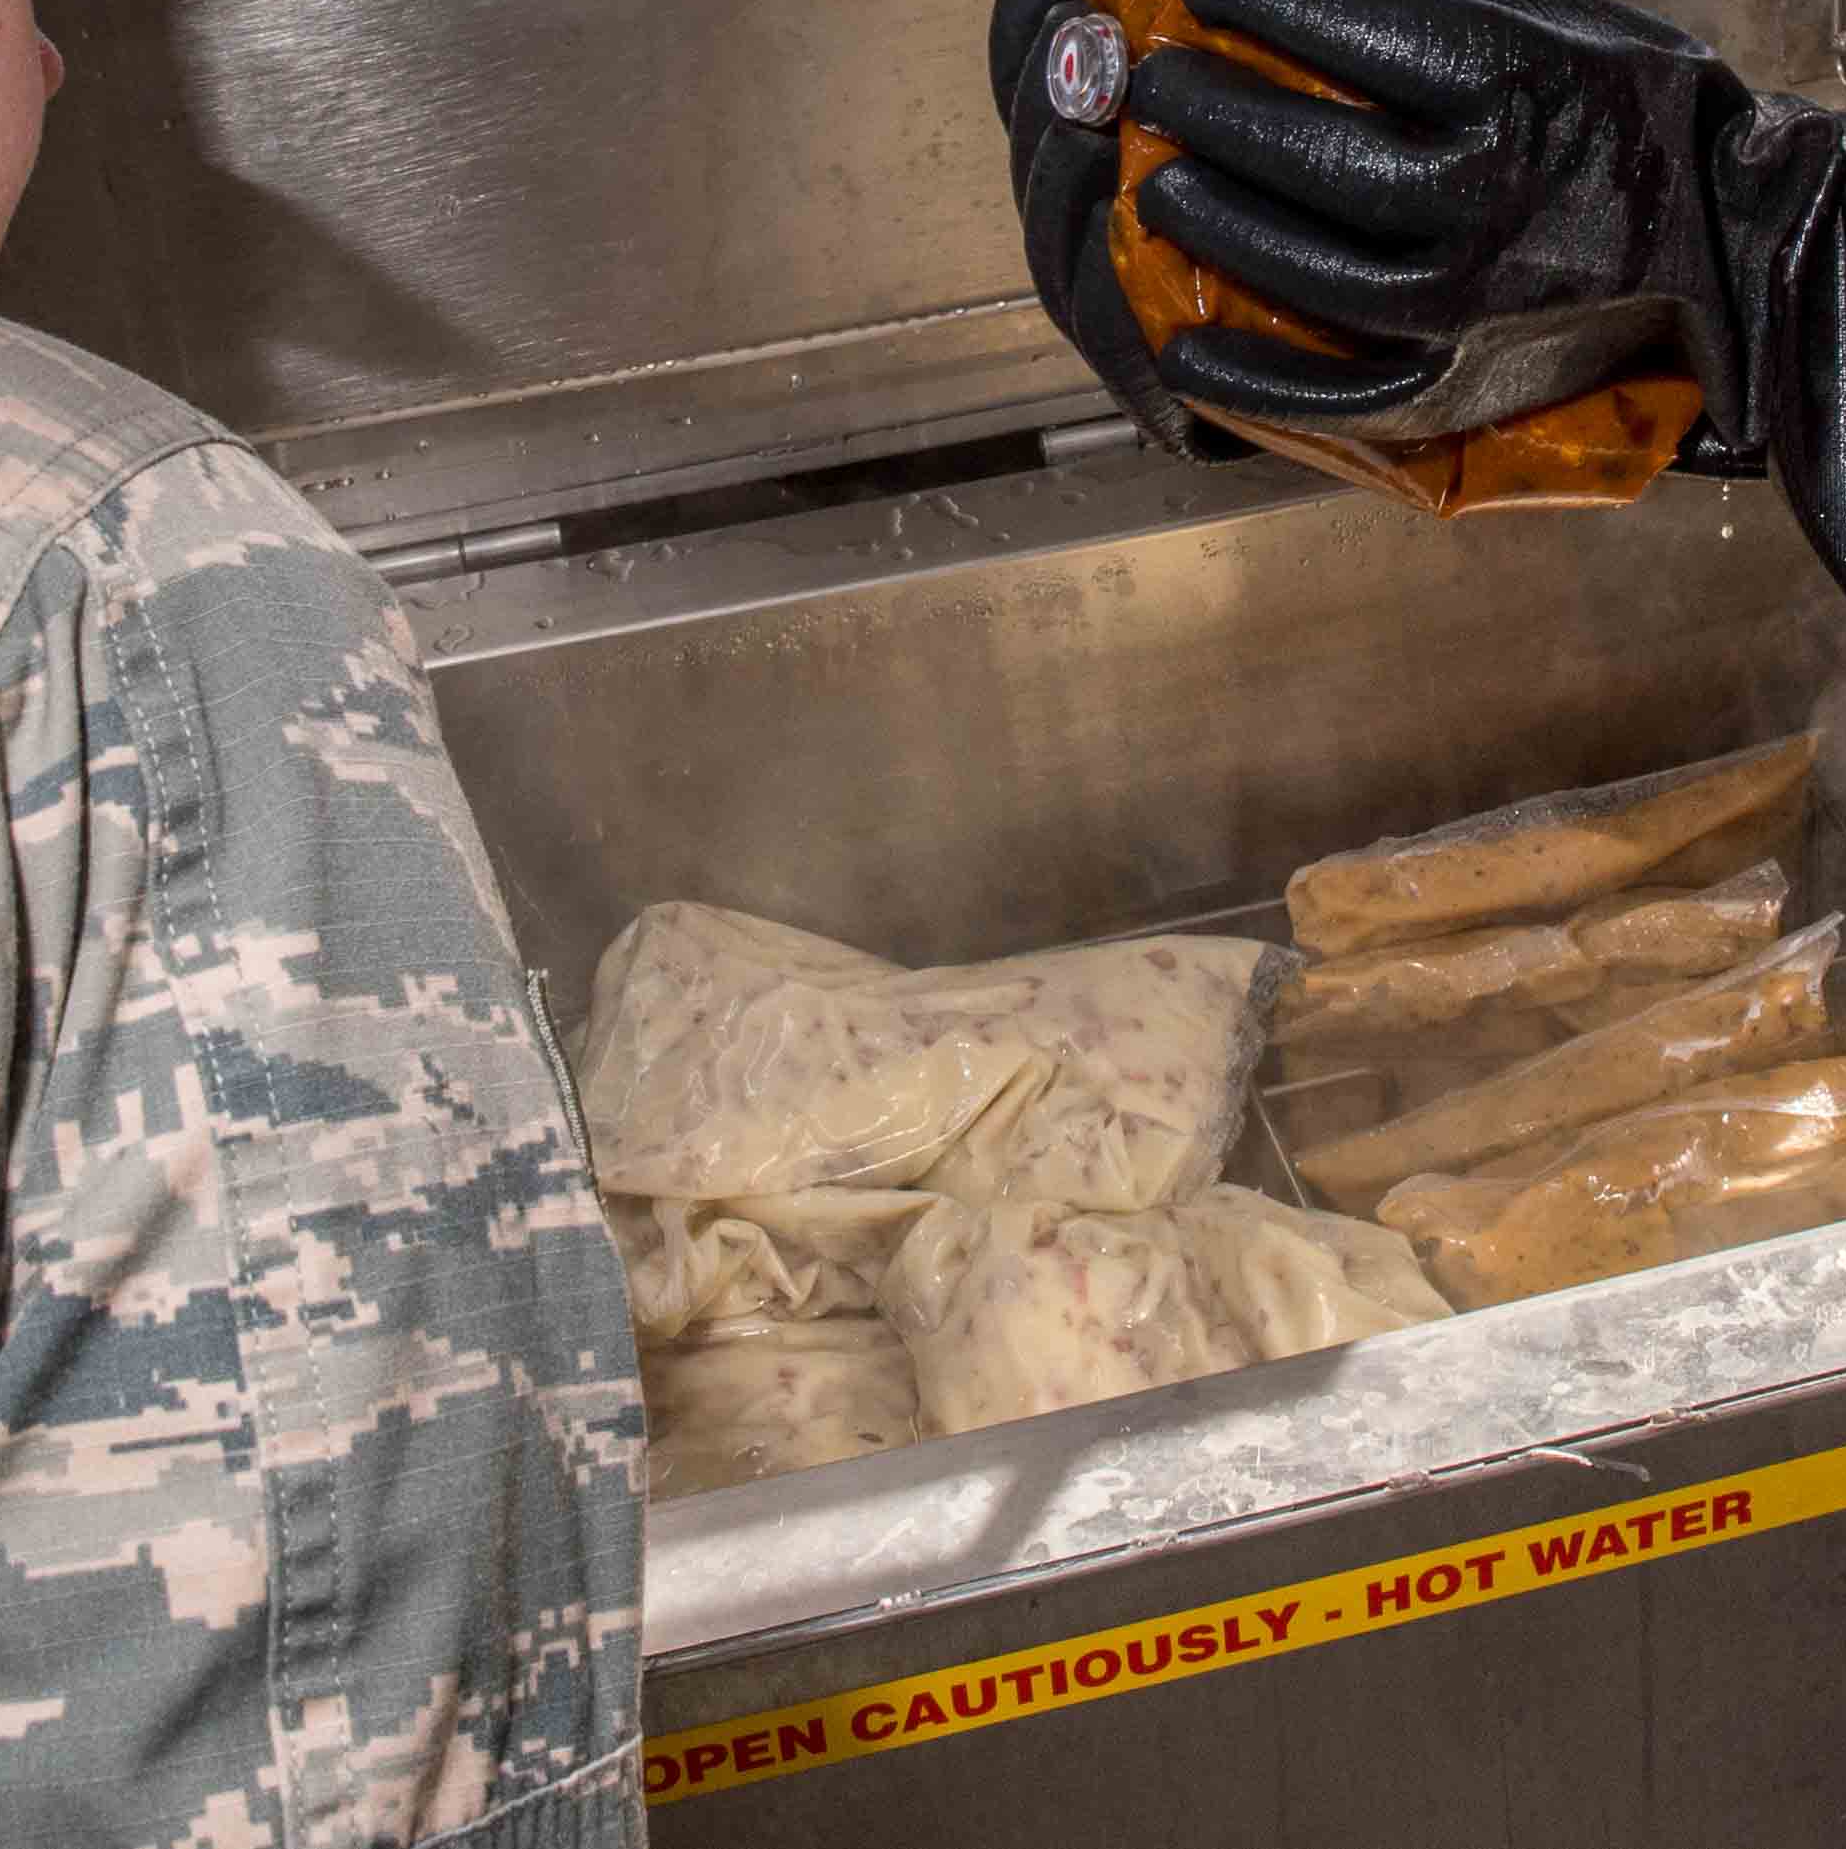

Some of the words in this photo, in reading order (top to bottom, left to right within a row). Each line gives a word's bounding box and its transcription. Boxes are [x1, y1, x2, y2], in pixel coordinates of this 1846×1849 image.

[643, 1718, 827, 1793] OPEN
[851, 1601, 1301, 1742] CAUTIOUSLY
[1366, 1551, 1506, 1618] HOT
[1527, 1490, 1752, 1577] WATER
